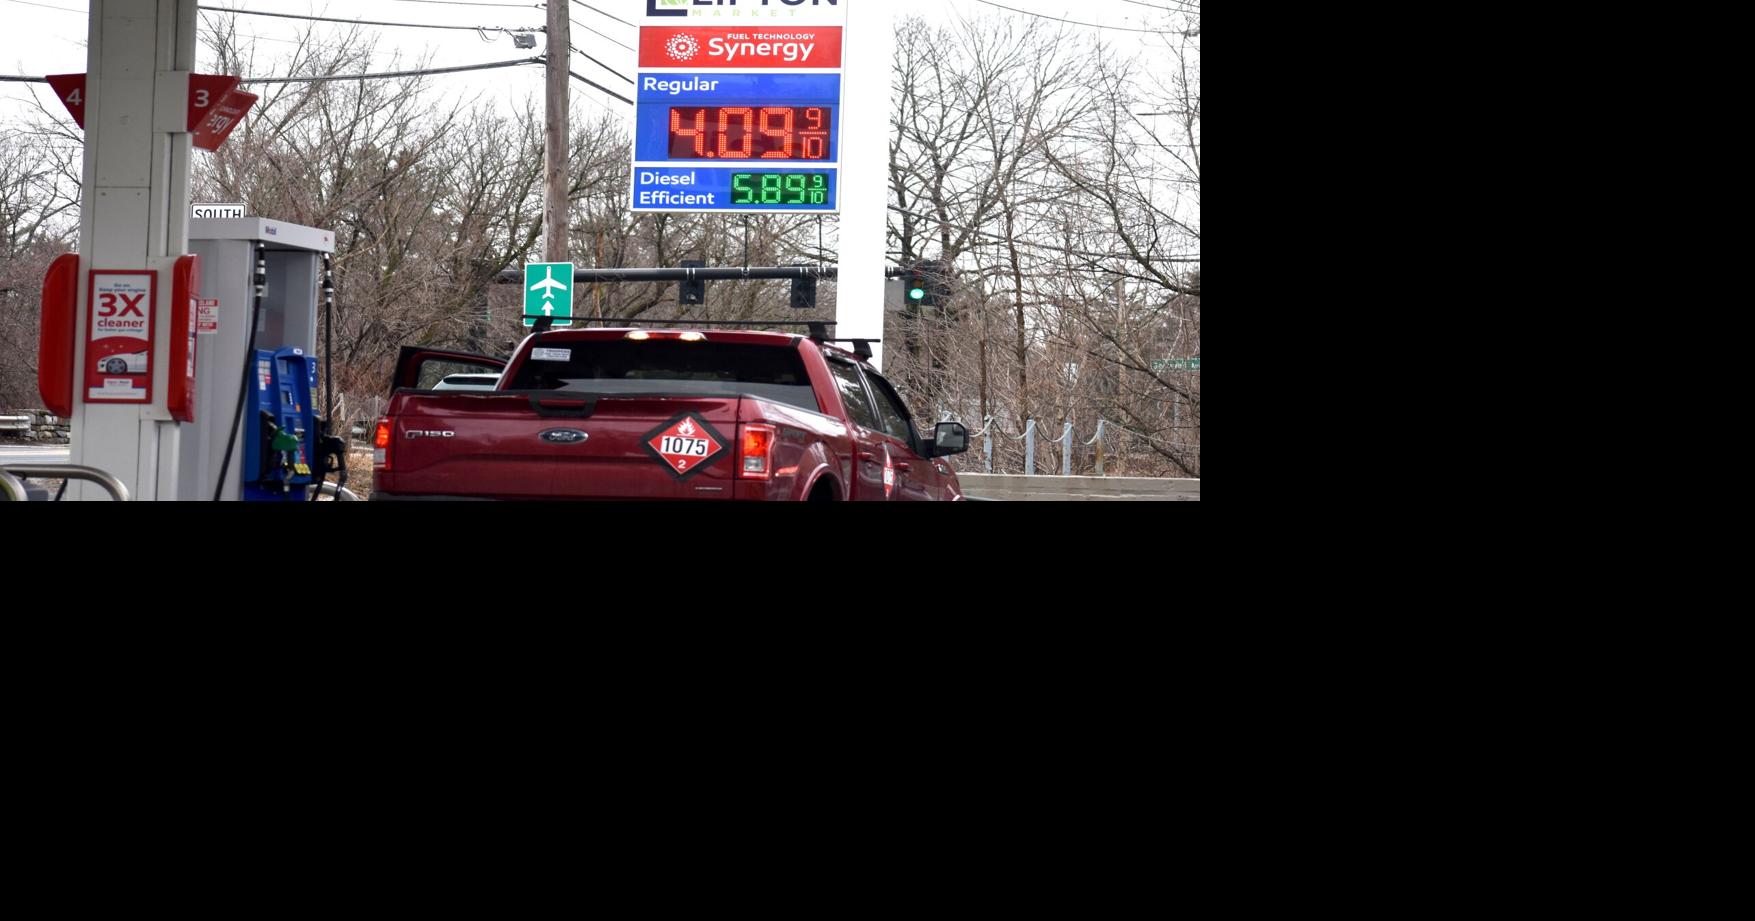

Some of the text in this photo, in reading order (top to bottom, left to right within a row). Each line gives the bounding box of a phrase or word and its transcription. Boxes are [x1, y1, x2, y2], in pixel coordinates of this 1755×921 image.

[692, 9, 796, 17] MARKET
[708, 37, 815, 62] Synergy
[643, 76, 719, 95] Regular
[66, 88, 82, 106] 4
[194, 89, 209, 108] 3
[670, 107, 793, 159] 4.09
[640, 171, 695, 185] Diesel
[640, 191, 715, 205] Efficient
[733, 174, 806, 204] 5.89
[195, 208, 242, 219] SOUTH
[98, 292, 145, 318] 3X
[97, 317, 145, 328] cleaner
[663, 437, 706, 456] 1075
[677, 459, 687, 469] 2
